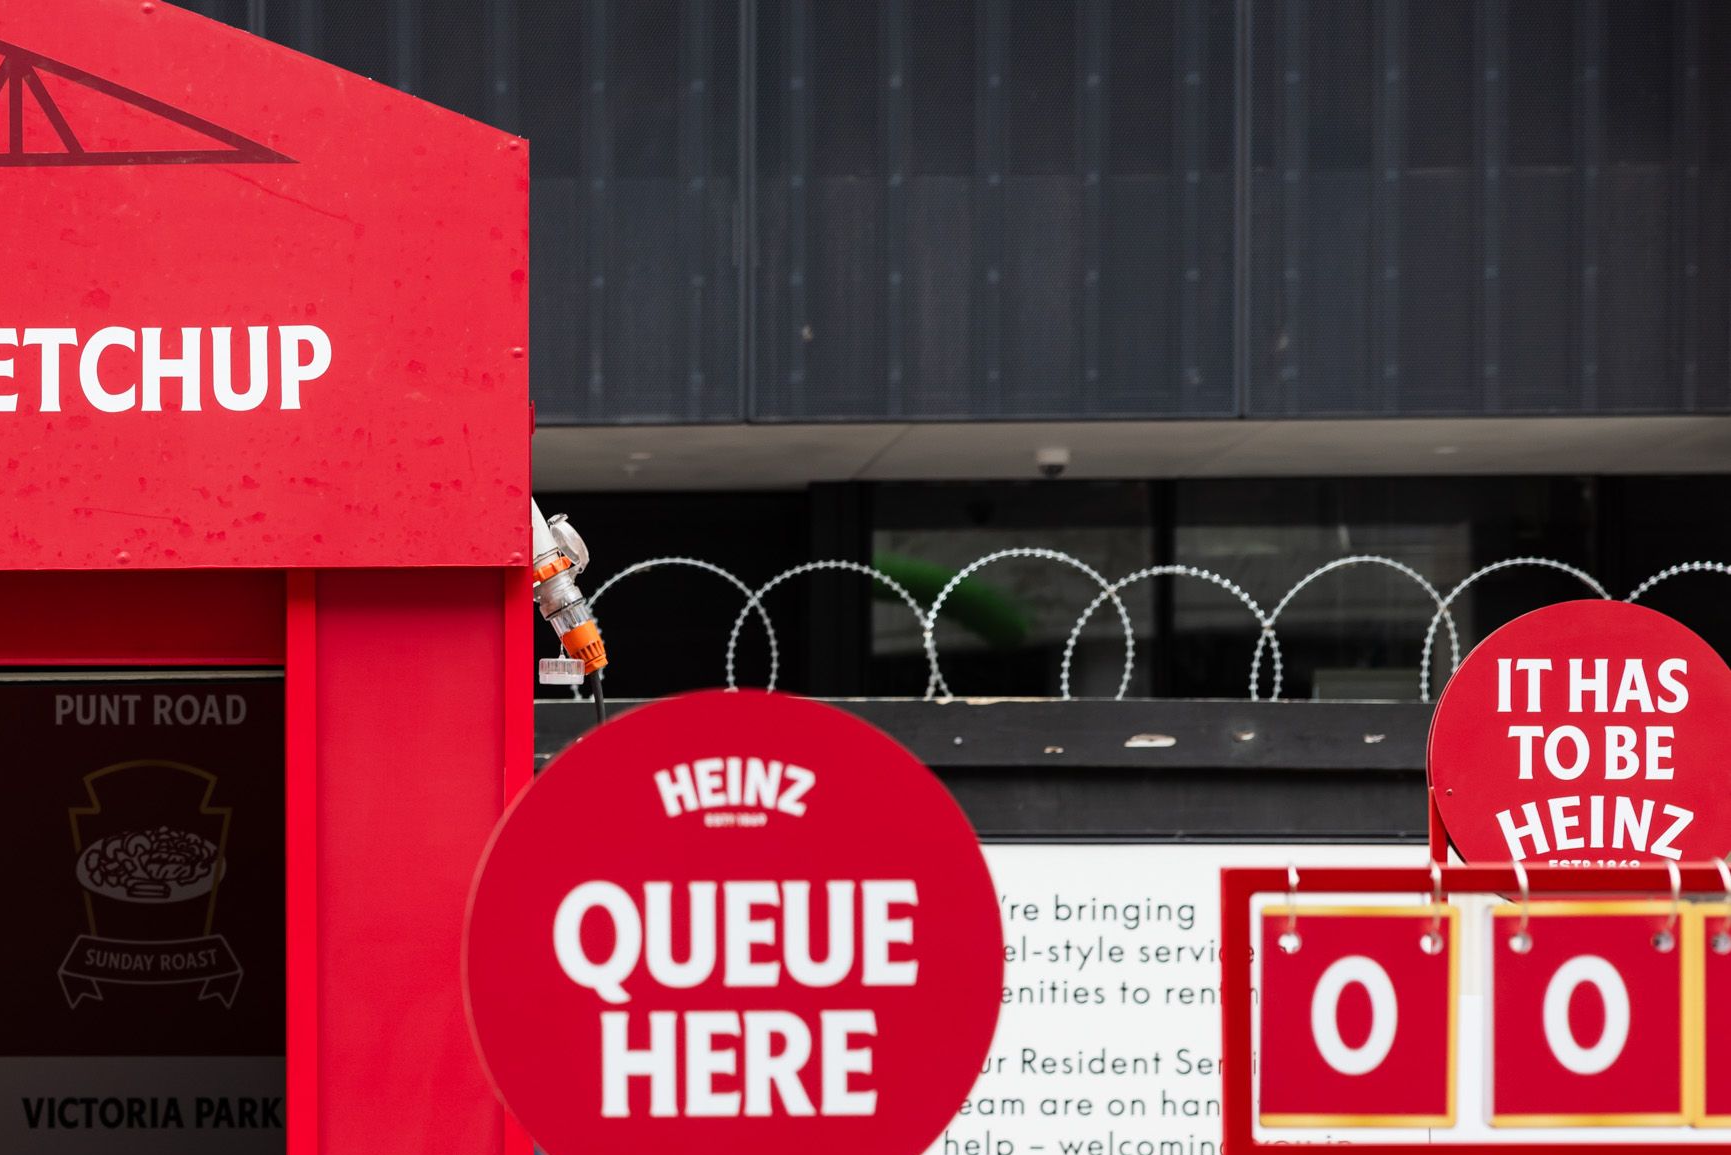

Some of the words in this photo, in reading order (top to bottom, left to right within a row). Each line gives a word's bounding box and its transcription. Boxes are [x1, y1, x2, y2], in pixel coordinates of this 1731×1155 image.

[1497, 657, 1552, 712] IT
[1568, 657, 1689, 713] HAS
[54, 694, 140, 726] PUNT
[153, 694, 247, 726] ROAD
[1508, 725, 1590, 780] TO
[1604, 725, 1675, 780] BE
[654, 757, 815, 817] HEINZ
[1495, 795, 1694, 861] HEINZ
[1054, 894, 1196, 930] bringing
[85, 947, 154, 971] SUNDAY
[160, 946, 218, 970] ROAST
[553, 880, 919, 1004] QUEUE
[1003, 936, 1125, 970] el-style
[1001, 980, 1106, 1004] enities
[1120, 980, 1150, 1004] to
[601, 1010, 877, 1118] HERE
[1021, 1047, 1162, 1075] Resident
[21, 1097, 184, 1129] VICTORIA
[194, 1097, 283, 1129] PARK
[958, 1095, 1025, 1116] eam
[1040, 1095, 1094, 1117] are
[1107, 1096, 1146, 1117] on
[1162, 1090, 1220, 1117] han
